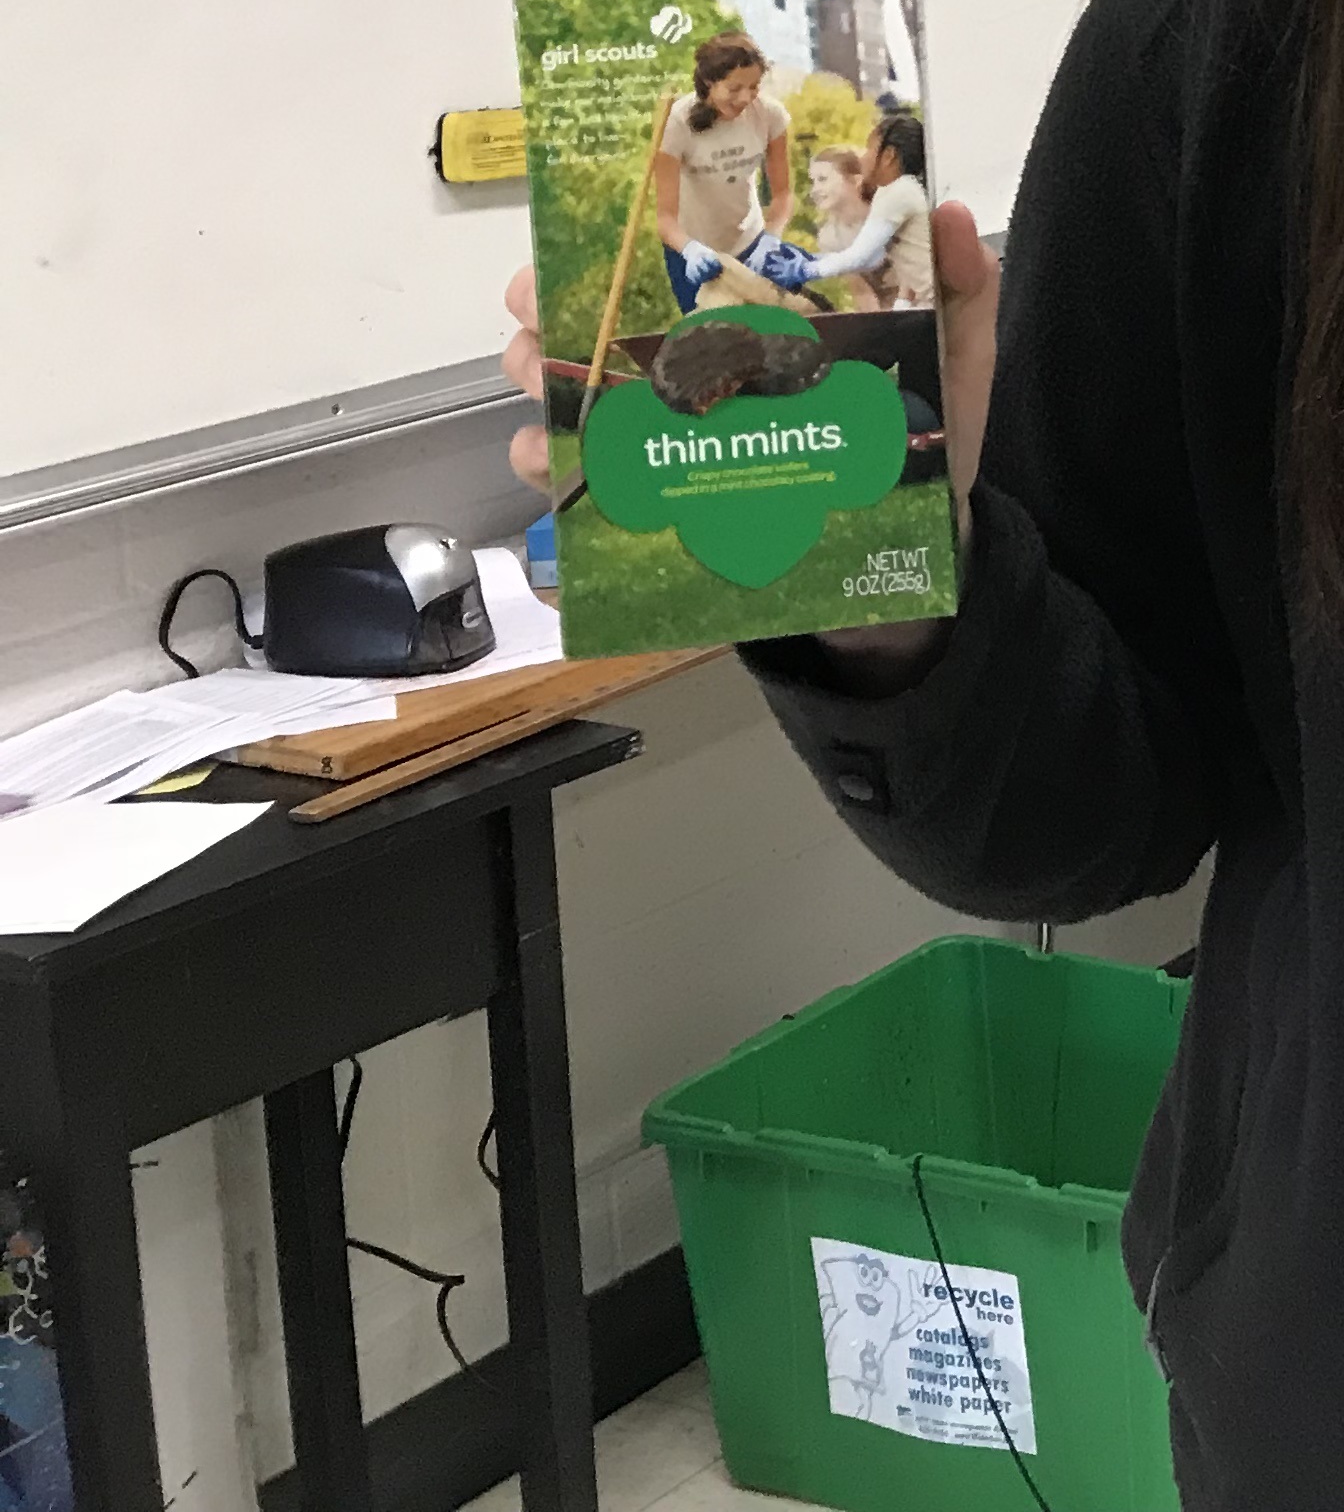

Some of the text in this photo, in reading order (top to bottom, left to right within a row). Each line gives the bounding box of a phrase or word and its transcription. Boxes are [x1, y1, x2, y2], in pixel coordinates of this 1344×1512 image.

[541, 41, 658, 71] girl scouts
[644, 429, 723, 467] thin
[867, 547, 929, 571] NET WT
[842, 577, 853, 597] 9
[855, 574, 880, 596] OZ
[923, 1282, 1015, 1310] recycle
[976, 1307, 1014, 1325] here
[916, 1328, 989, 1351] catalogs
[908, 1385, 1012, 1417] white paper
